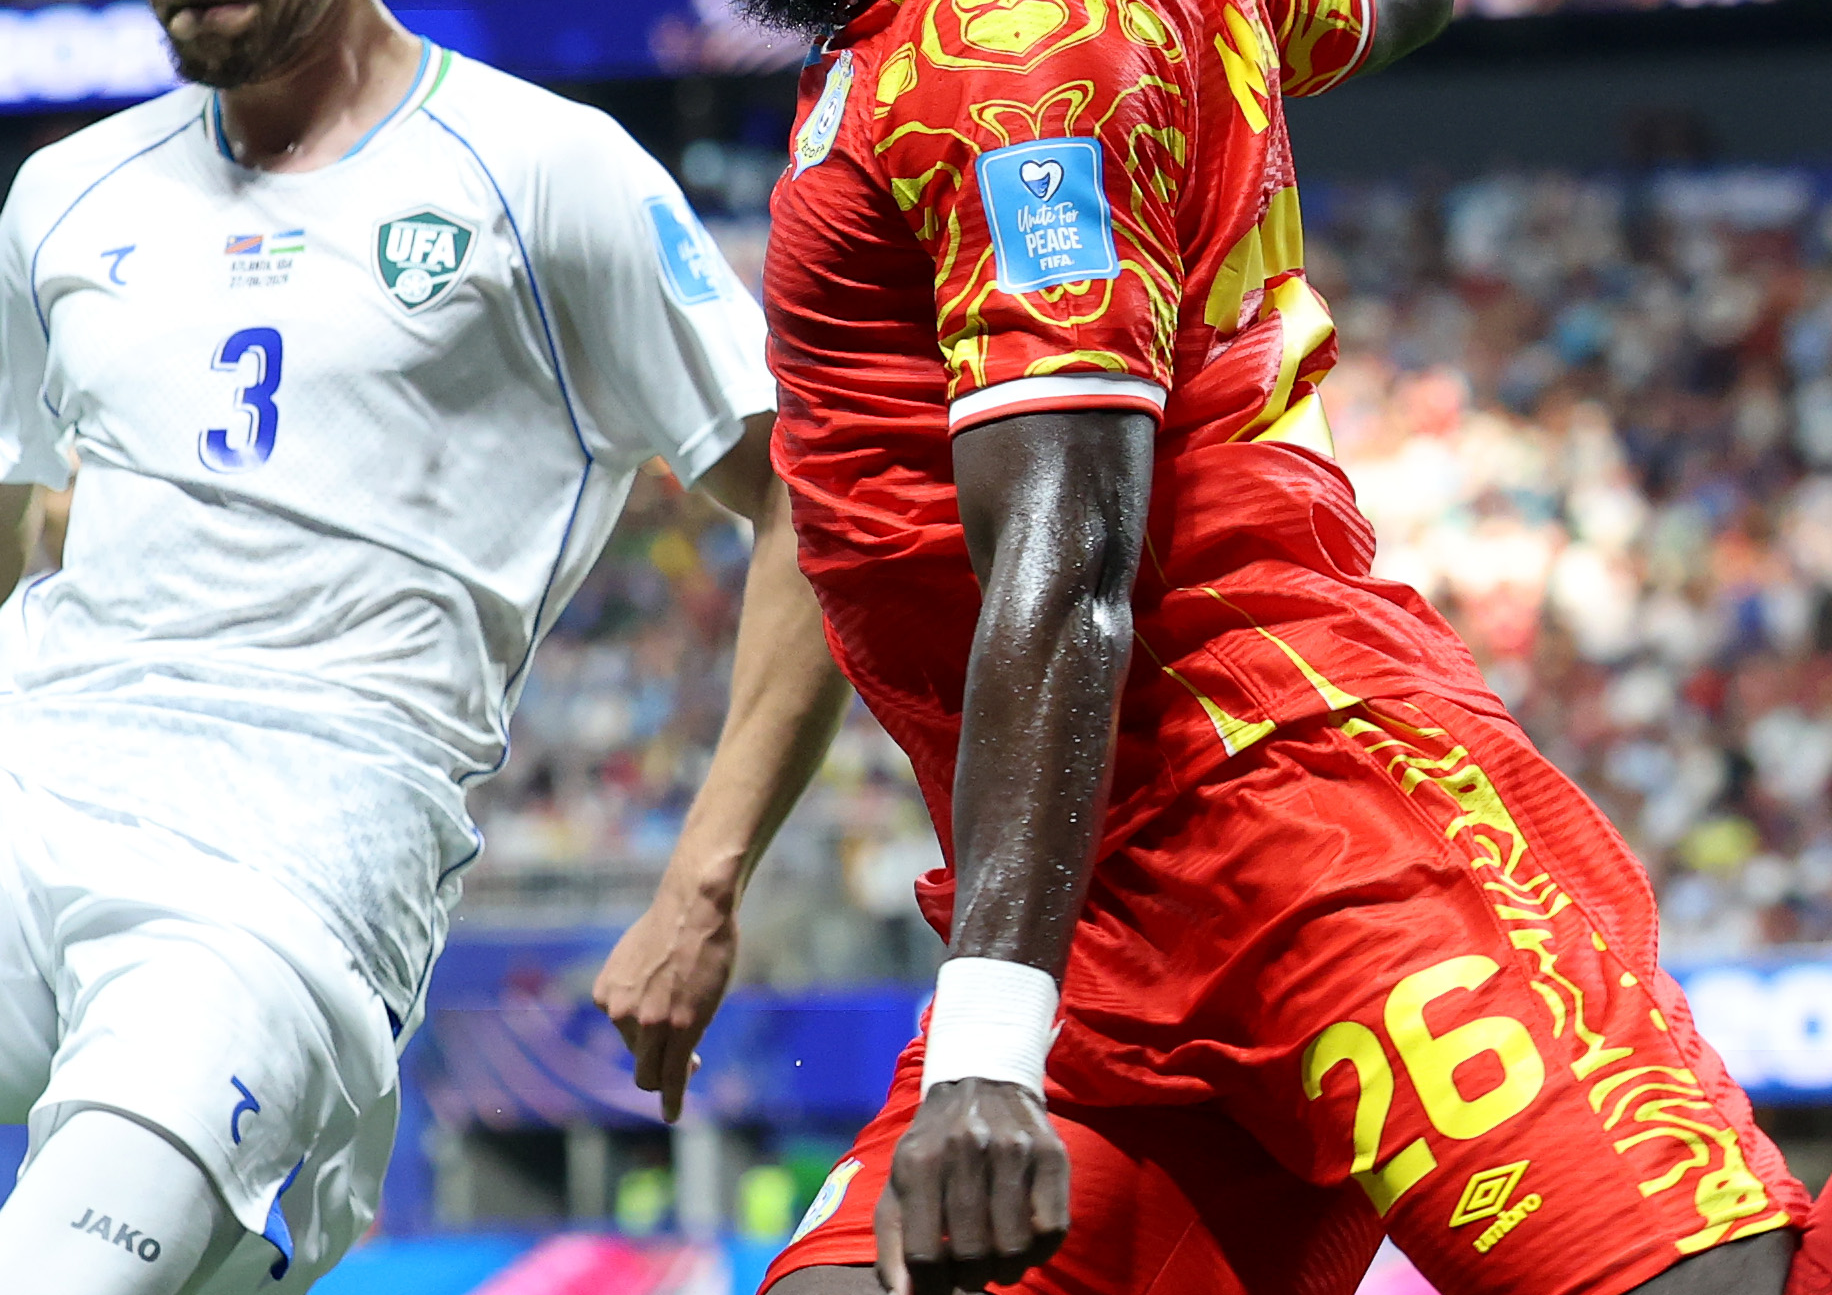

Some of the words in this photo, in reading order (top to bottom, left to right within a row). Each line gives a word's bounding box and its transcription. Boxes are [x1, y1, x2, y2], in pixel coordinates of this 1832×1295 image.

[1017, 205, 1055, 233] Unite
[1054, 201, 1080, 224] For
[1025, 227, 1082, 257] PEACE
[385, 226, 457, 269] UFA
[200, 327, 283, 473] 3
[1301, 954, 1545, 1218] 26
[71, 1207, 161, 1262] JAKO
[1472, 1193, 1543, 1253] umbro
